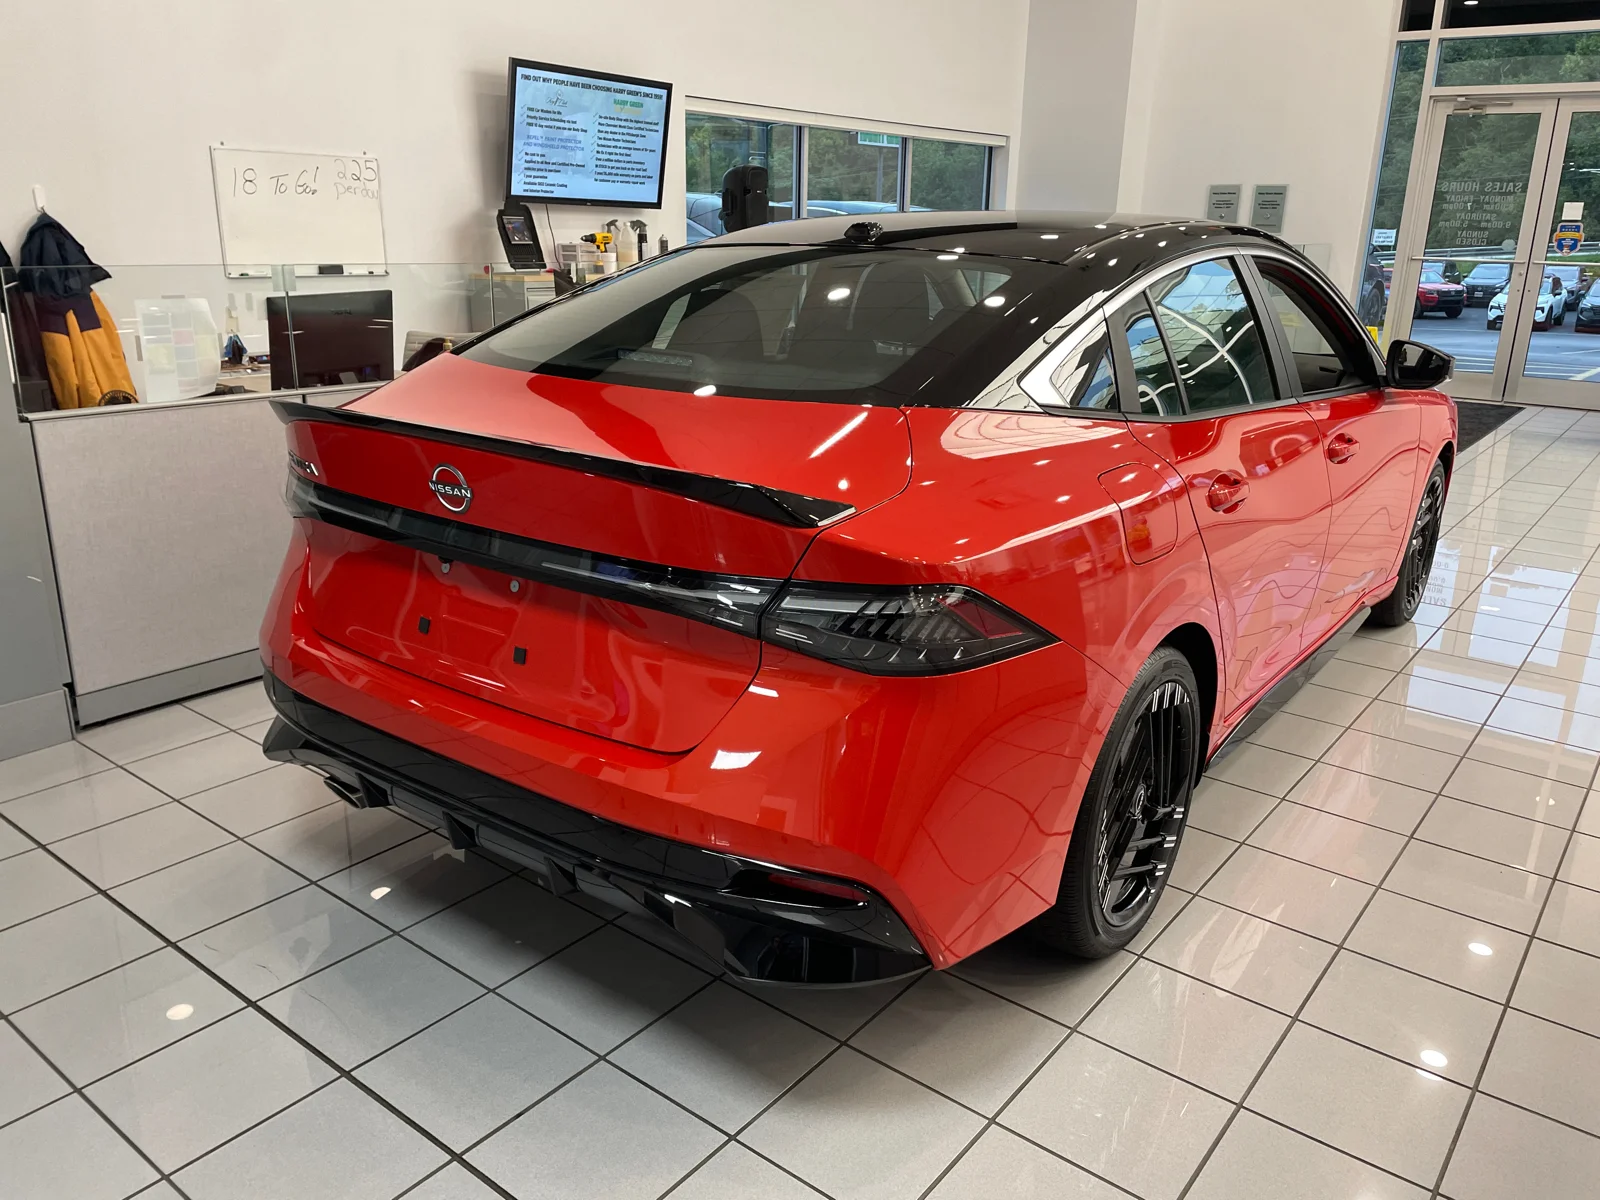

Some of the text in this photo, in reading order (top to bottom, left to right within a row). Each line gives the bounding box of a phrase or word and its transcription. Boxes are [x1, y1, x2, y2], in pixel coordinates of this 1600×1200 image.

[592, 84, 612, 92] CHOOSING
[233, 168, 258, 197] 18
[270, 174, 288, 195] To
[429, 482, 472, 498] NISSAN
